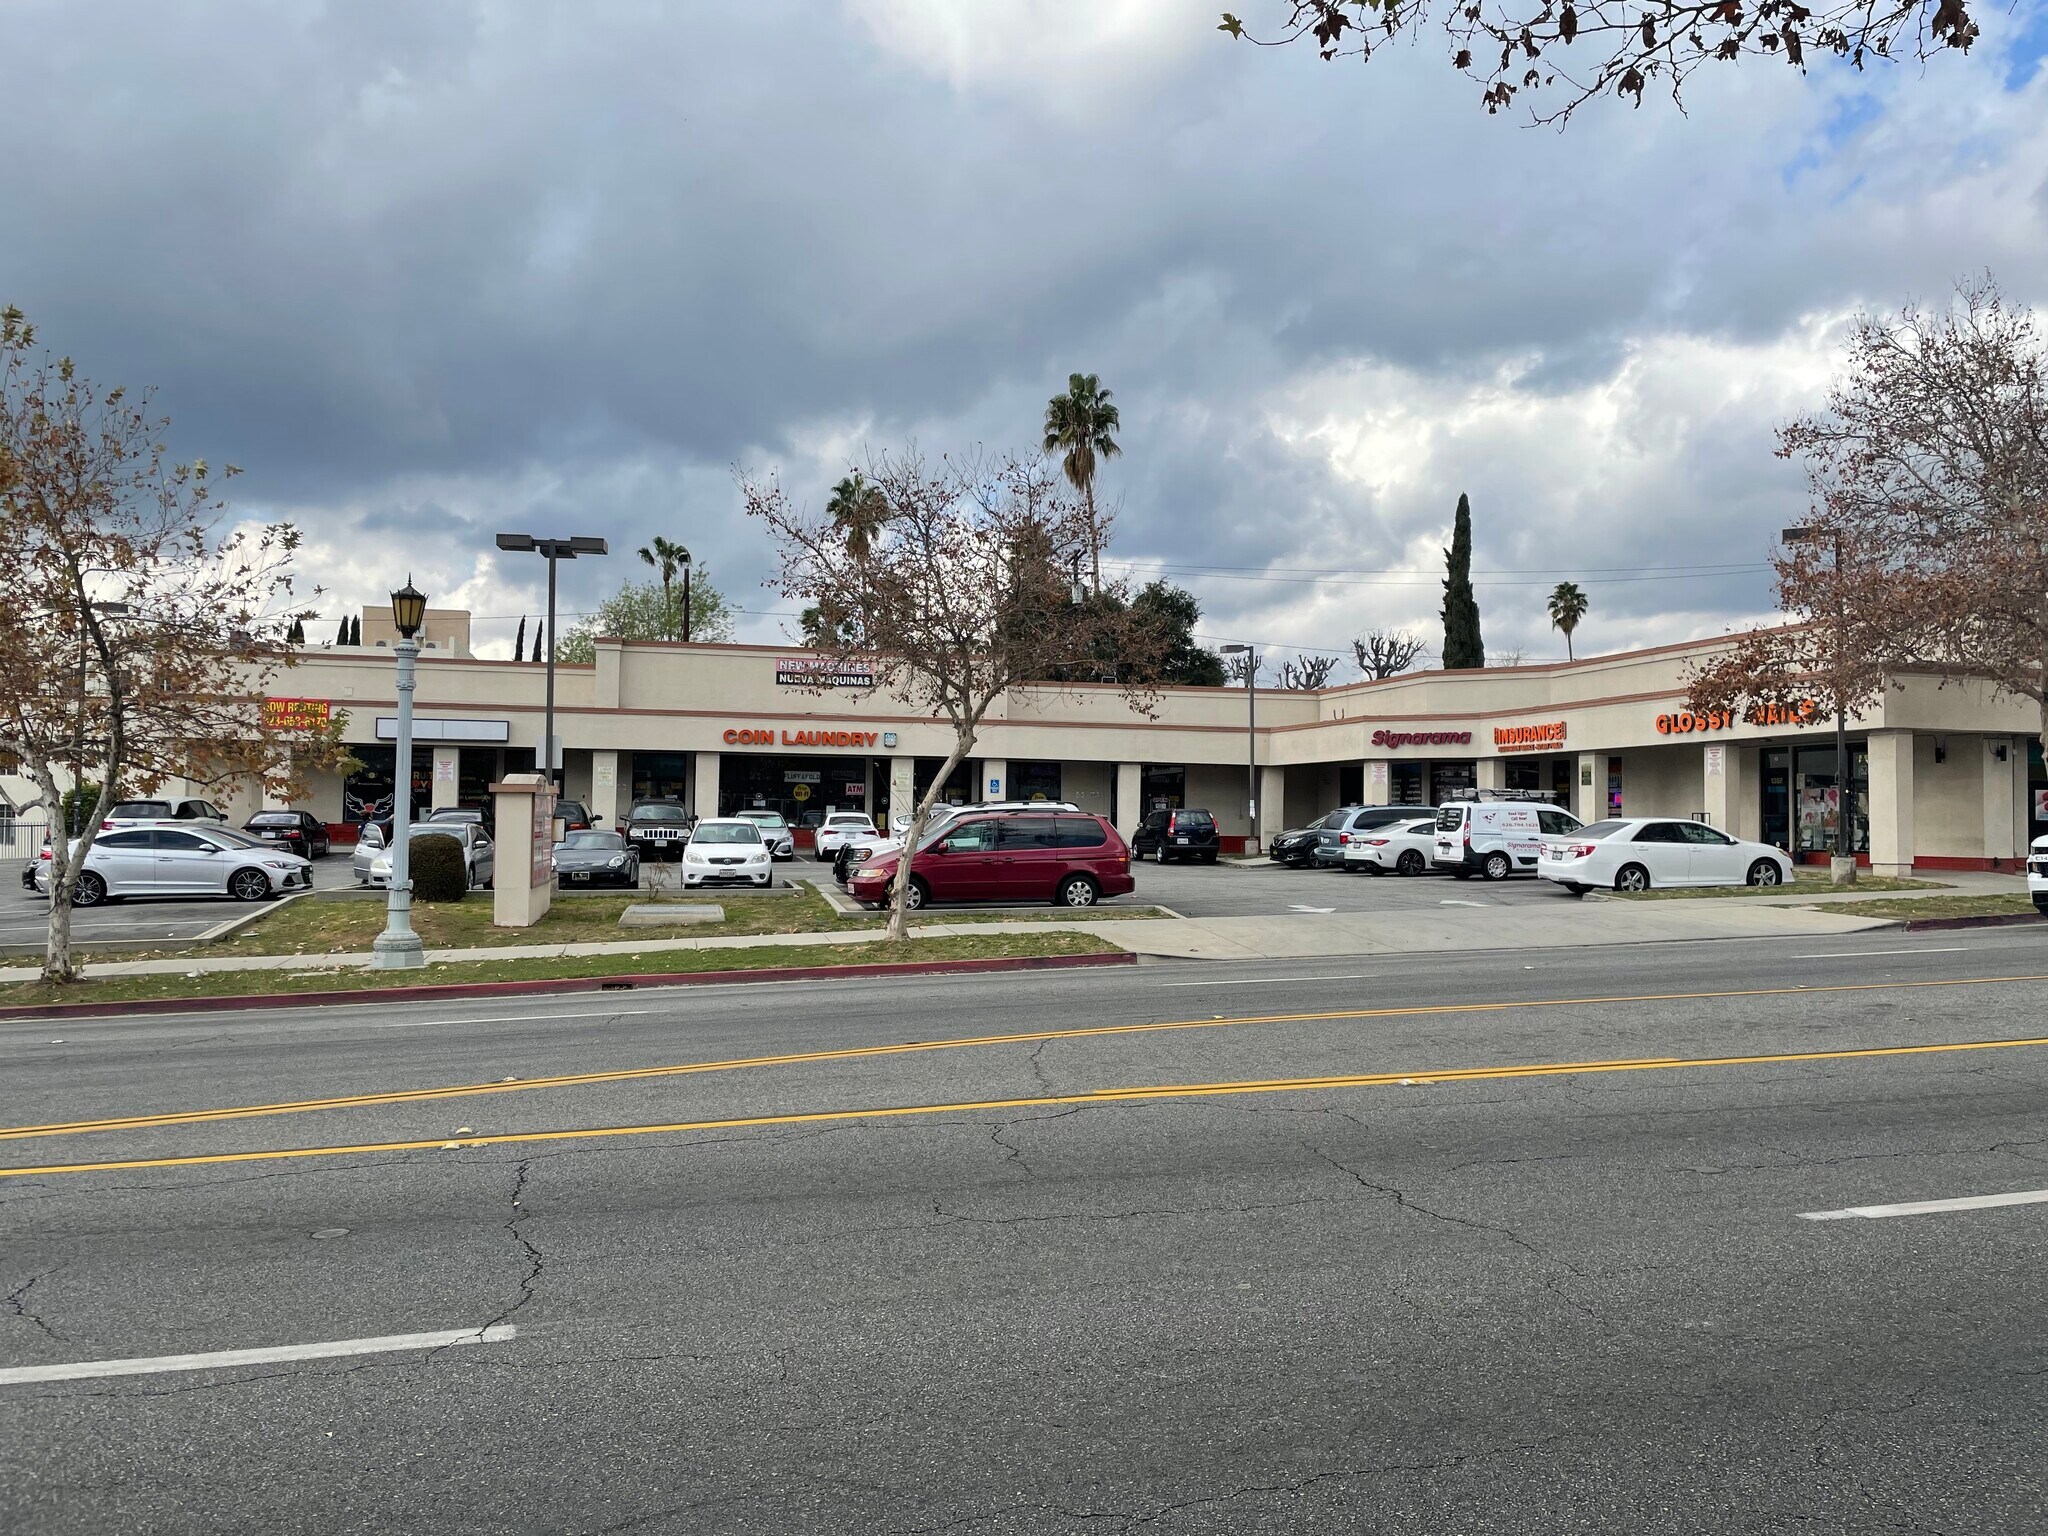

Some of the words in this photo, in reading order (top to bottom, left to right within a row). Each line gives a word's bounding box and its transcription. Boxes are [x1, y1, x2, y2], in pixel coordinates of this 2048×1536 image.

[779, 660, 805, 670] NEW
[779, 674, 814, 684] NUEVA
[1656, 709, 1732, 735] GLOSSY
[723, 729, 775, 745] COIN
[782, 730, 879, 747] LAUNDRY
[1371, 729, 1472, 749] Signarama
[1498, 723, 1563, 745] INSURANCE
[847, 785, 863, 793] ATM
[1507, 841, 1541, 849] Signarama
